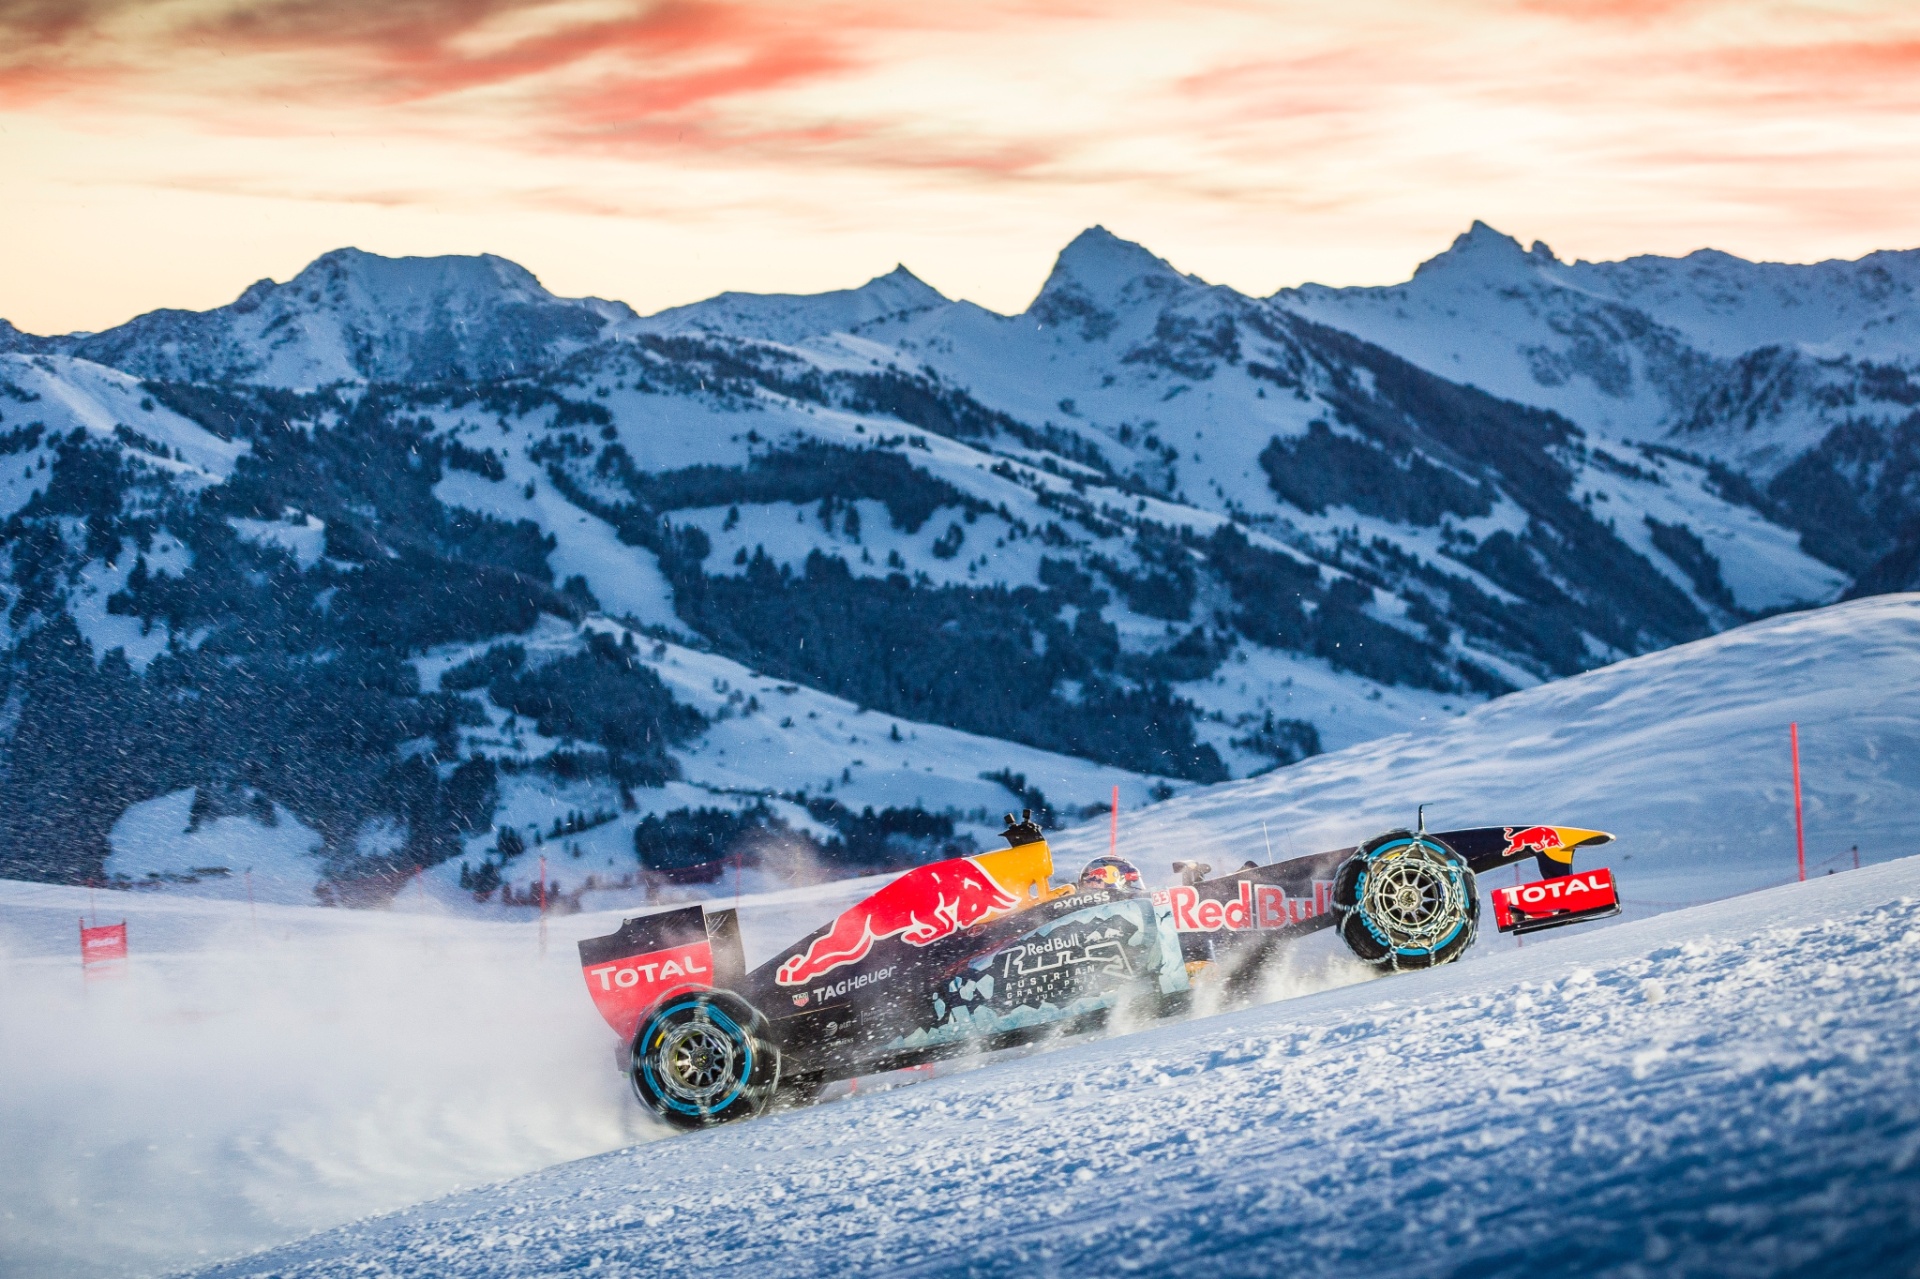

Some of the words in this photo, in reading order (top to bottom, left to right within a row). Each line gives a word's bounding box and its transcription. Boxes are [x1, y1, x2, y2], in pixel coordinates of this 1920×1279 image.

[1054, 890, 1110, 909] exness
[1153, 890, 1170, 906] 33
[1501, 875, 1610, 906] TOTAL
[1169, 881, 1251, 931] Red
[1027, 940, 1054, 956] Red
[1054, 933, 1080, 951] Bull
[591, 956, 707, 991] TOTAL
[1005, 964, 1095, 991] AUSTRIAN
[1006, 983, 1054, 999] GRAND
[1064, 974, 1097, 987] PRIX
[1035, 990, 1063, 1001] JULY
